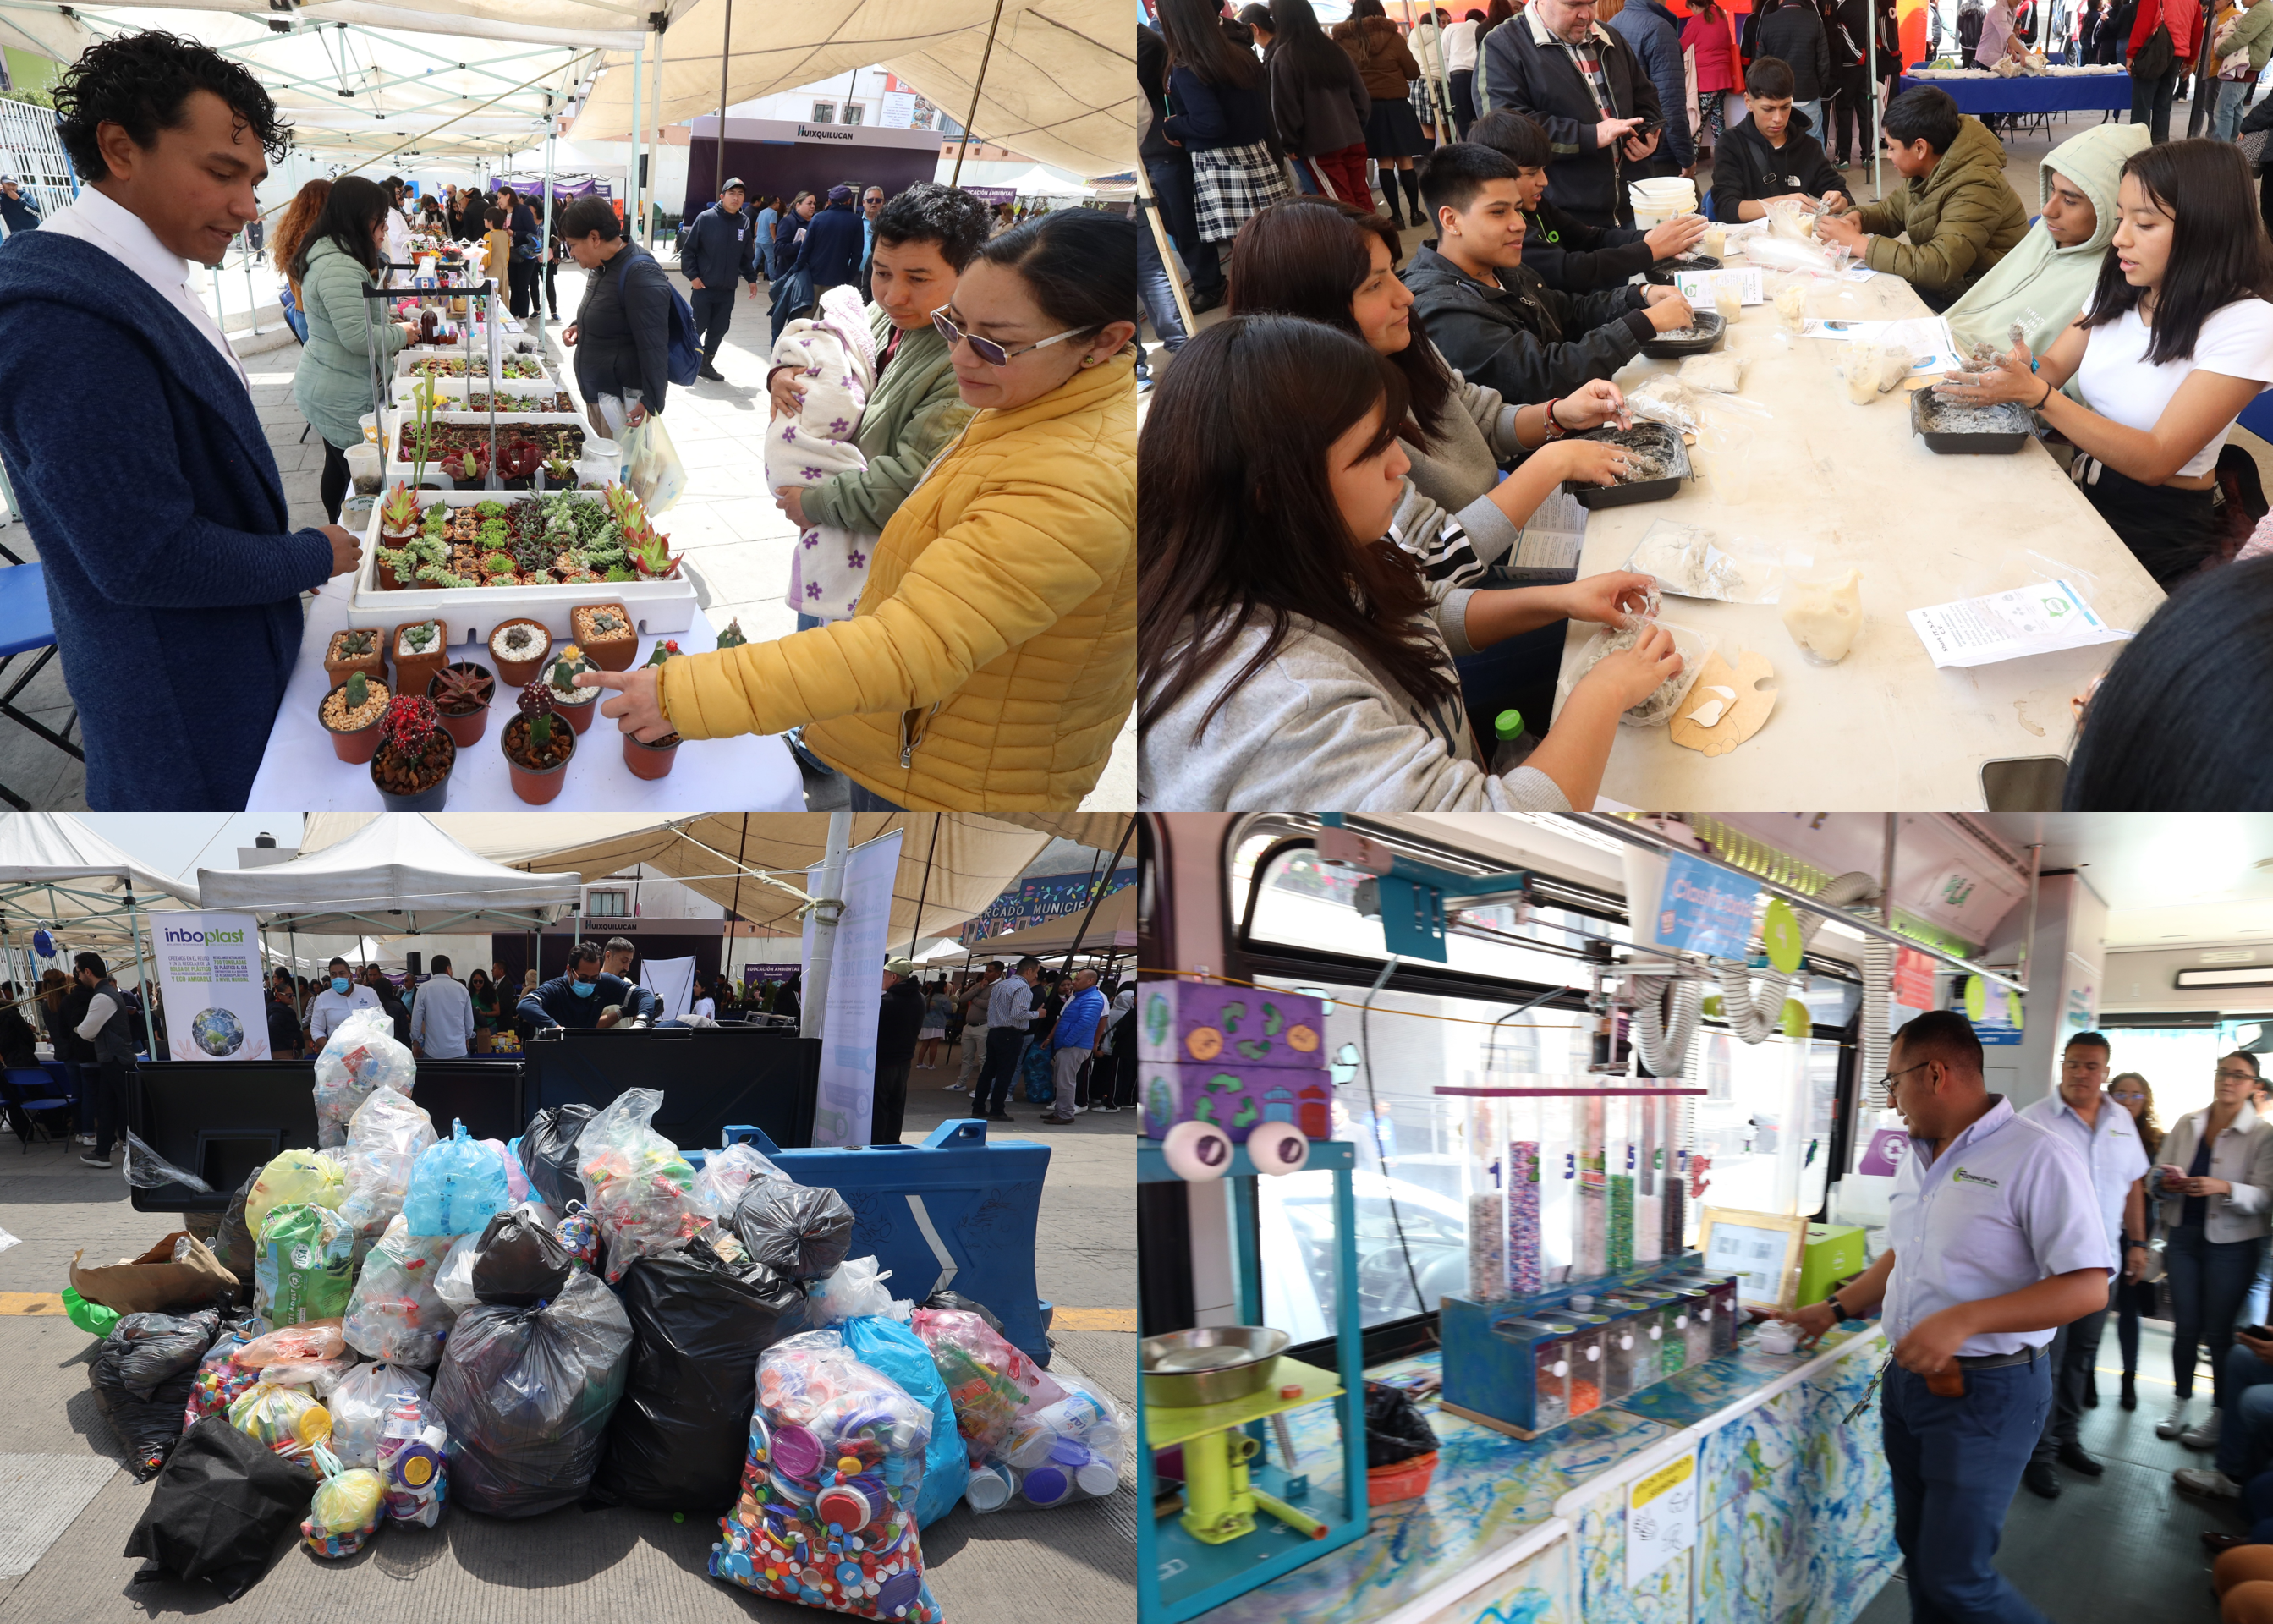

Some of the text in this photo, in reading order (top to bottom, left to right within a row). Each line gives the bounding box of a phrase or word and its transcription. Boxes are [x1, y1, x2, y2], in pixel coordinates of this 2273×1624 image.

[798, 125, 854, 140] HUIXQUILUCAN
[2027, 318, 2037, 328] AND
[1935, 636, 1948, 652] Shark
[981, 906, 1024, 917] RCADO
[585, 920, 637, 930] HUIXQUILUCAN
[164, 927, 244, 946] inboplast
[297, 1249, 307, 1265] USA
[289, 1289, 298, 1311] ADULT
